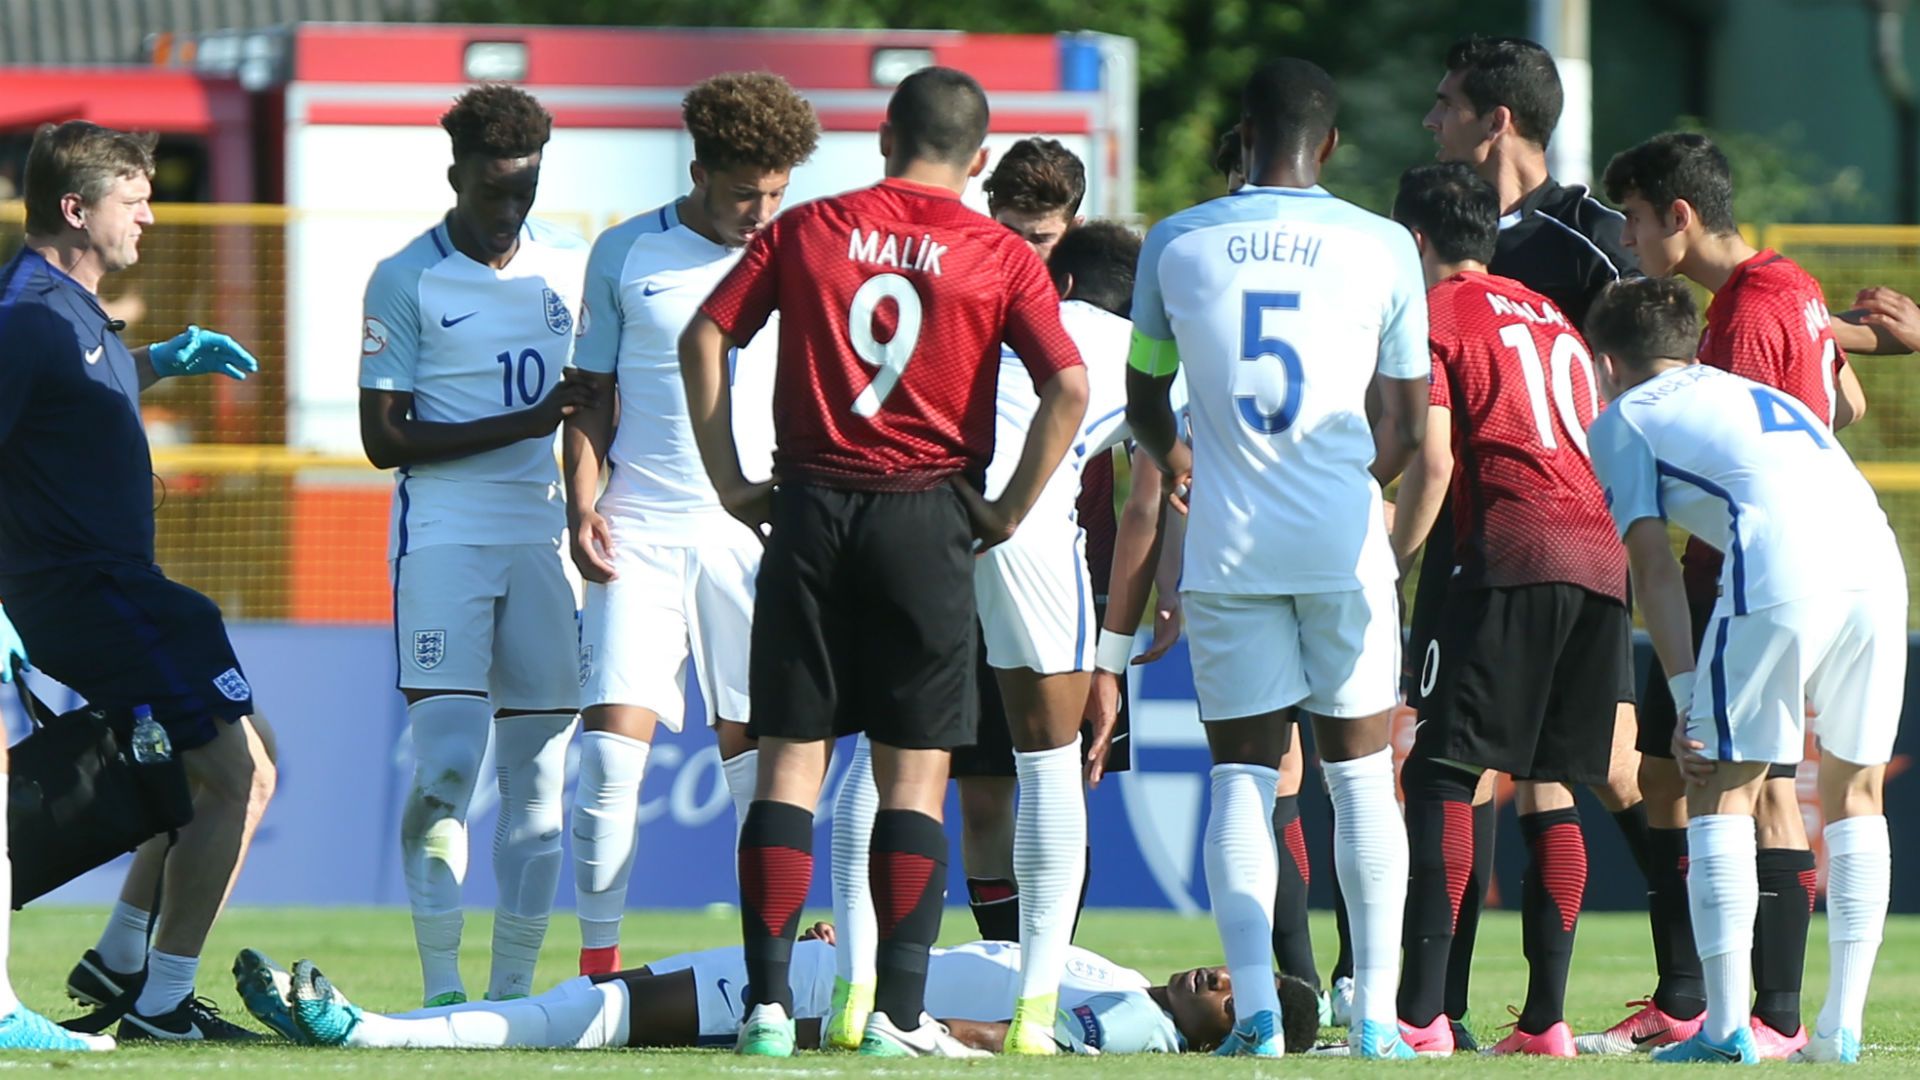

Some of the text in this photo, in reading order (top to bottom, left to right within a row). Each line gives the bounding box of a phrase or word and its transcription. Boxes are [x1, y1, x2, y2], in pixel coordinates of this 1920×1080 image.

[848, 228, 948, 277] MALİK
[1227, 224, 1322, 267] GUÉHI
[849, 273, 923, 419] 9
[1233, 289, 1304, 434] 5
[496, 348, 545, 406] 10
[1499, 323, 1600, 458] 10
[1749, 388, 1831, 449] 4
